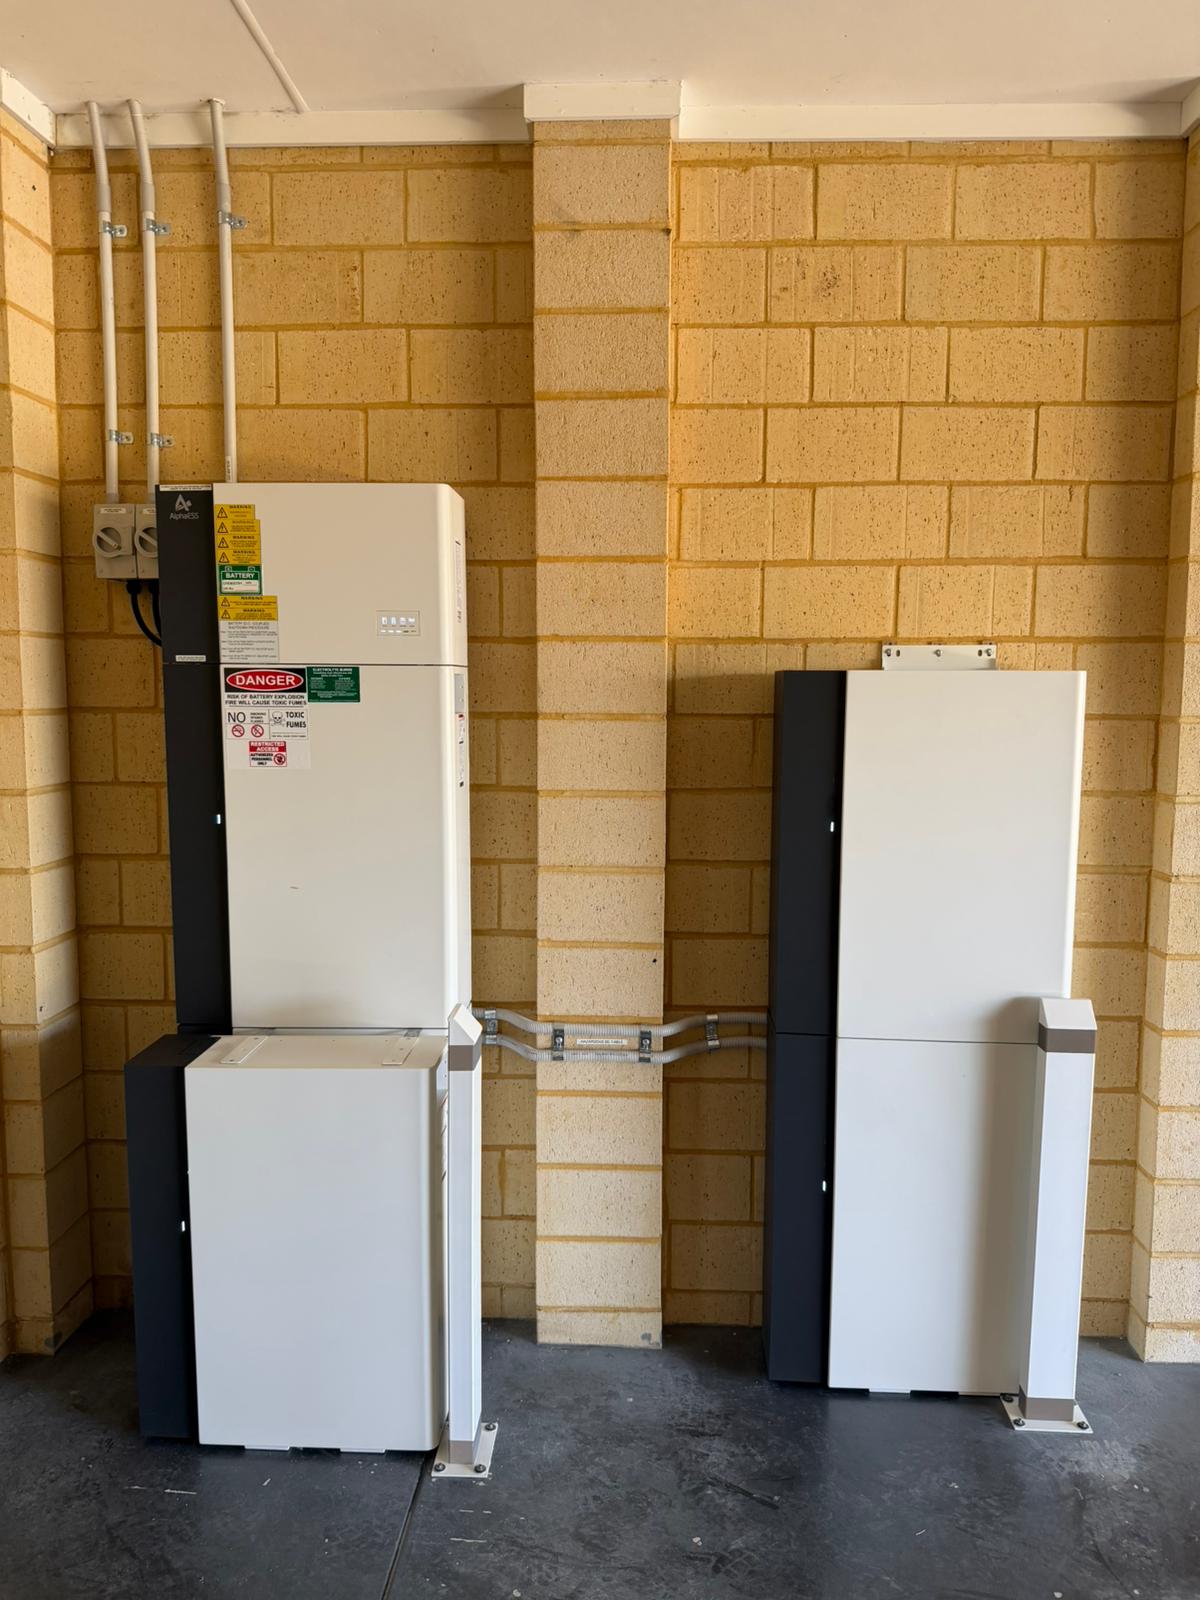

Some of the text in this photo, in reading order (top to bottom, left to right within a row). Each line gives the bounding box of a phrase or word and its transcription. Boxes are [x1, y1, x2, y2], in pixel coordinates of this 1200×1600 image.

[169, 512, 199, 520] AlphaESS
[235, 675, 296, 686] DANGER
[227, 712, 246, 723] NO
